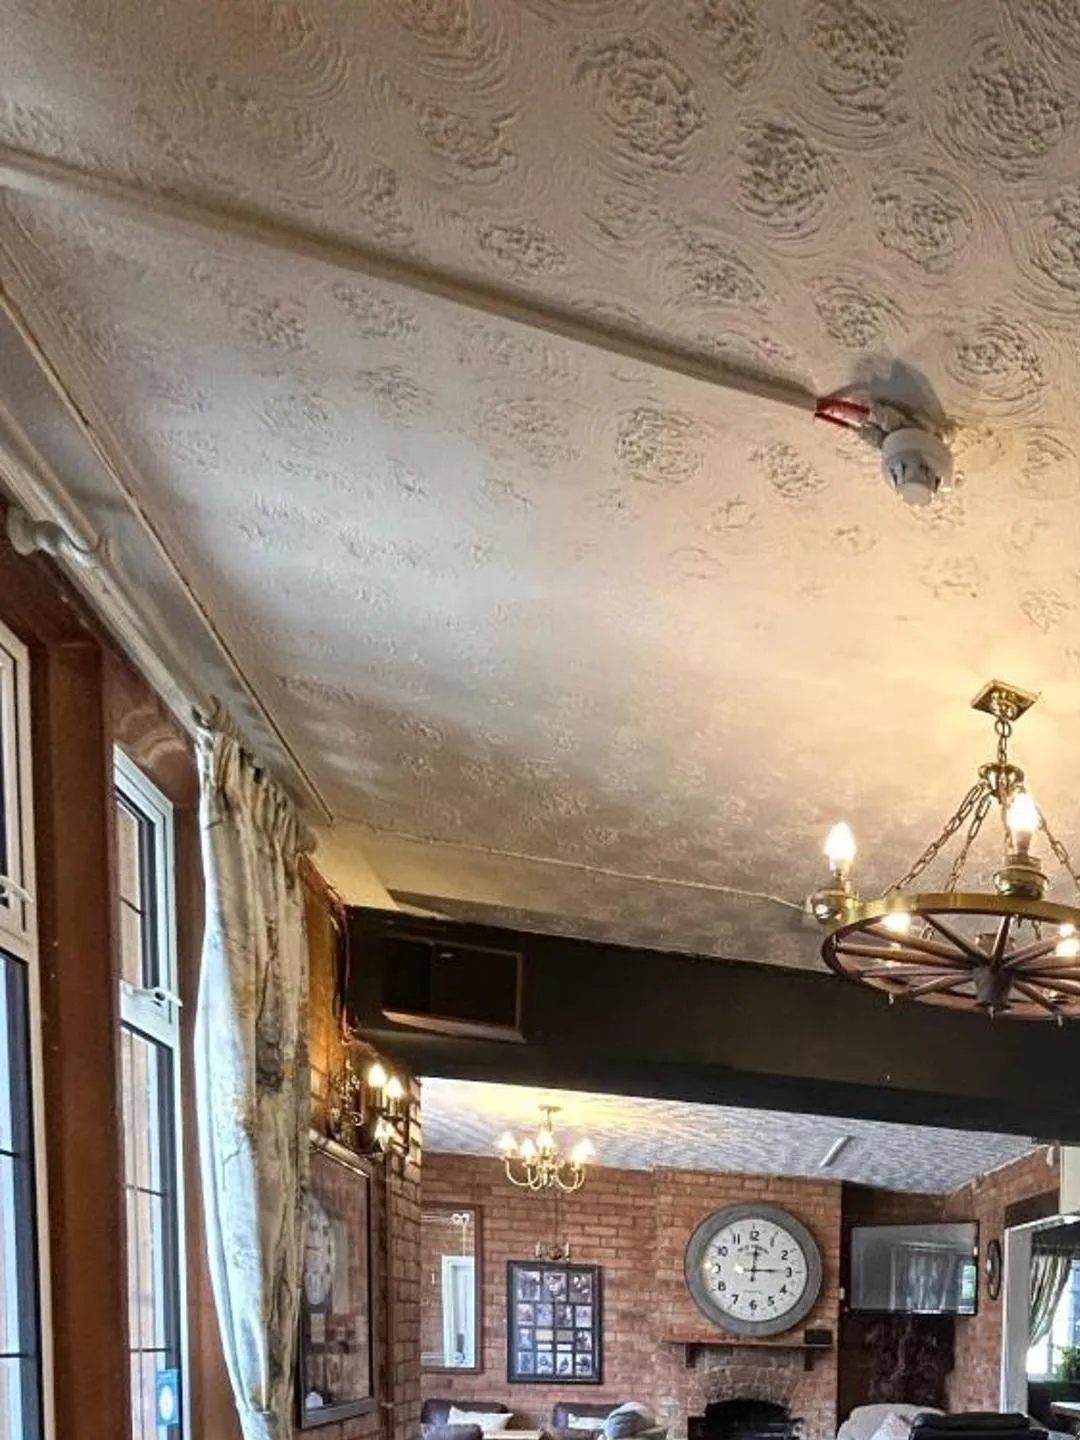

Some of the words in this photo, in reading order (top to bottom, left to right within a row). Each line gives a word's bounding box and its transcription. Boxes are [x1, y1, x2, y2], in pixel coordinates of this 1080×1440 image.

[732, 1233, 741, 1245] 11
[749, 1230, 760, 1242] 12
[718, 1246, 729, 1257] 10
[781, 1249, 789, 1261] 2
[785, 1266, 793, 1278] 3
[718, 1280, 727, 1292] 8
[779, 1283, 787, 1294] 4
[731, 1293, 739, 1304] 7
[767, 1295, 775, 1307] 5
[749, 1299, 758, 1311] 6
